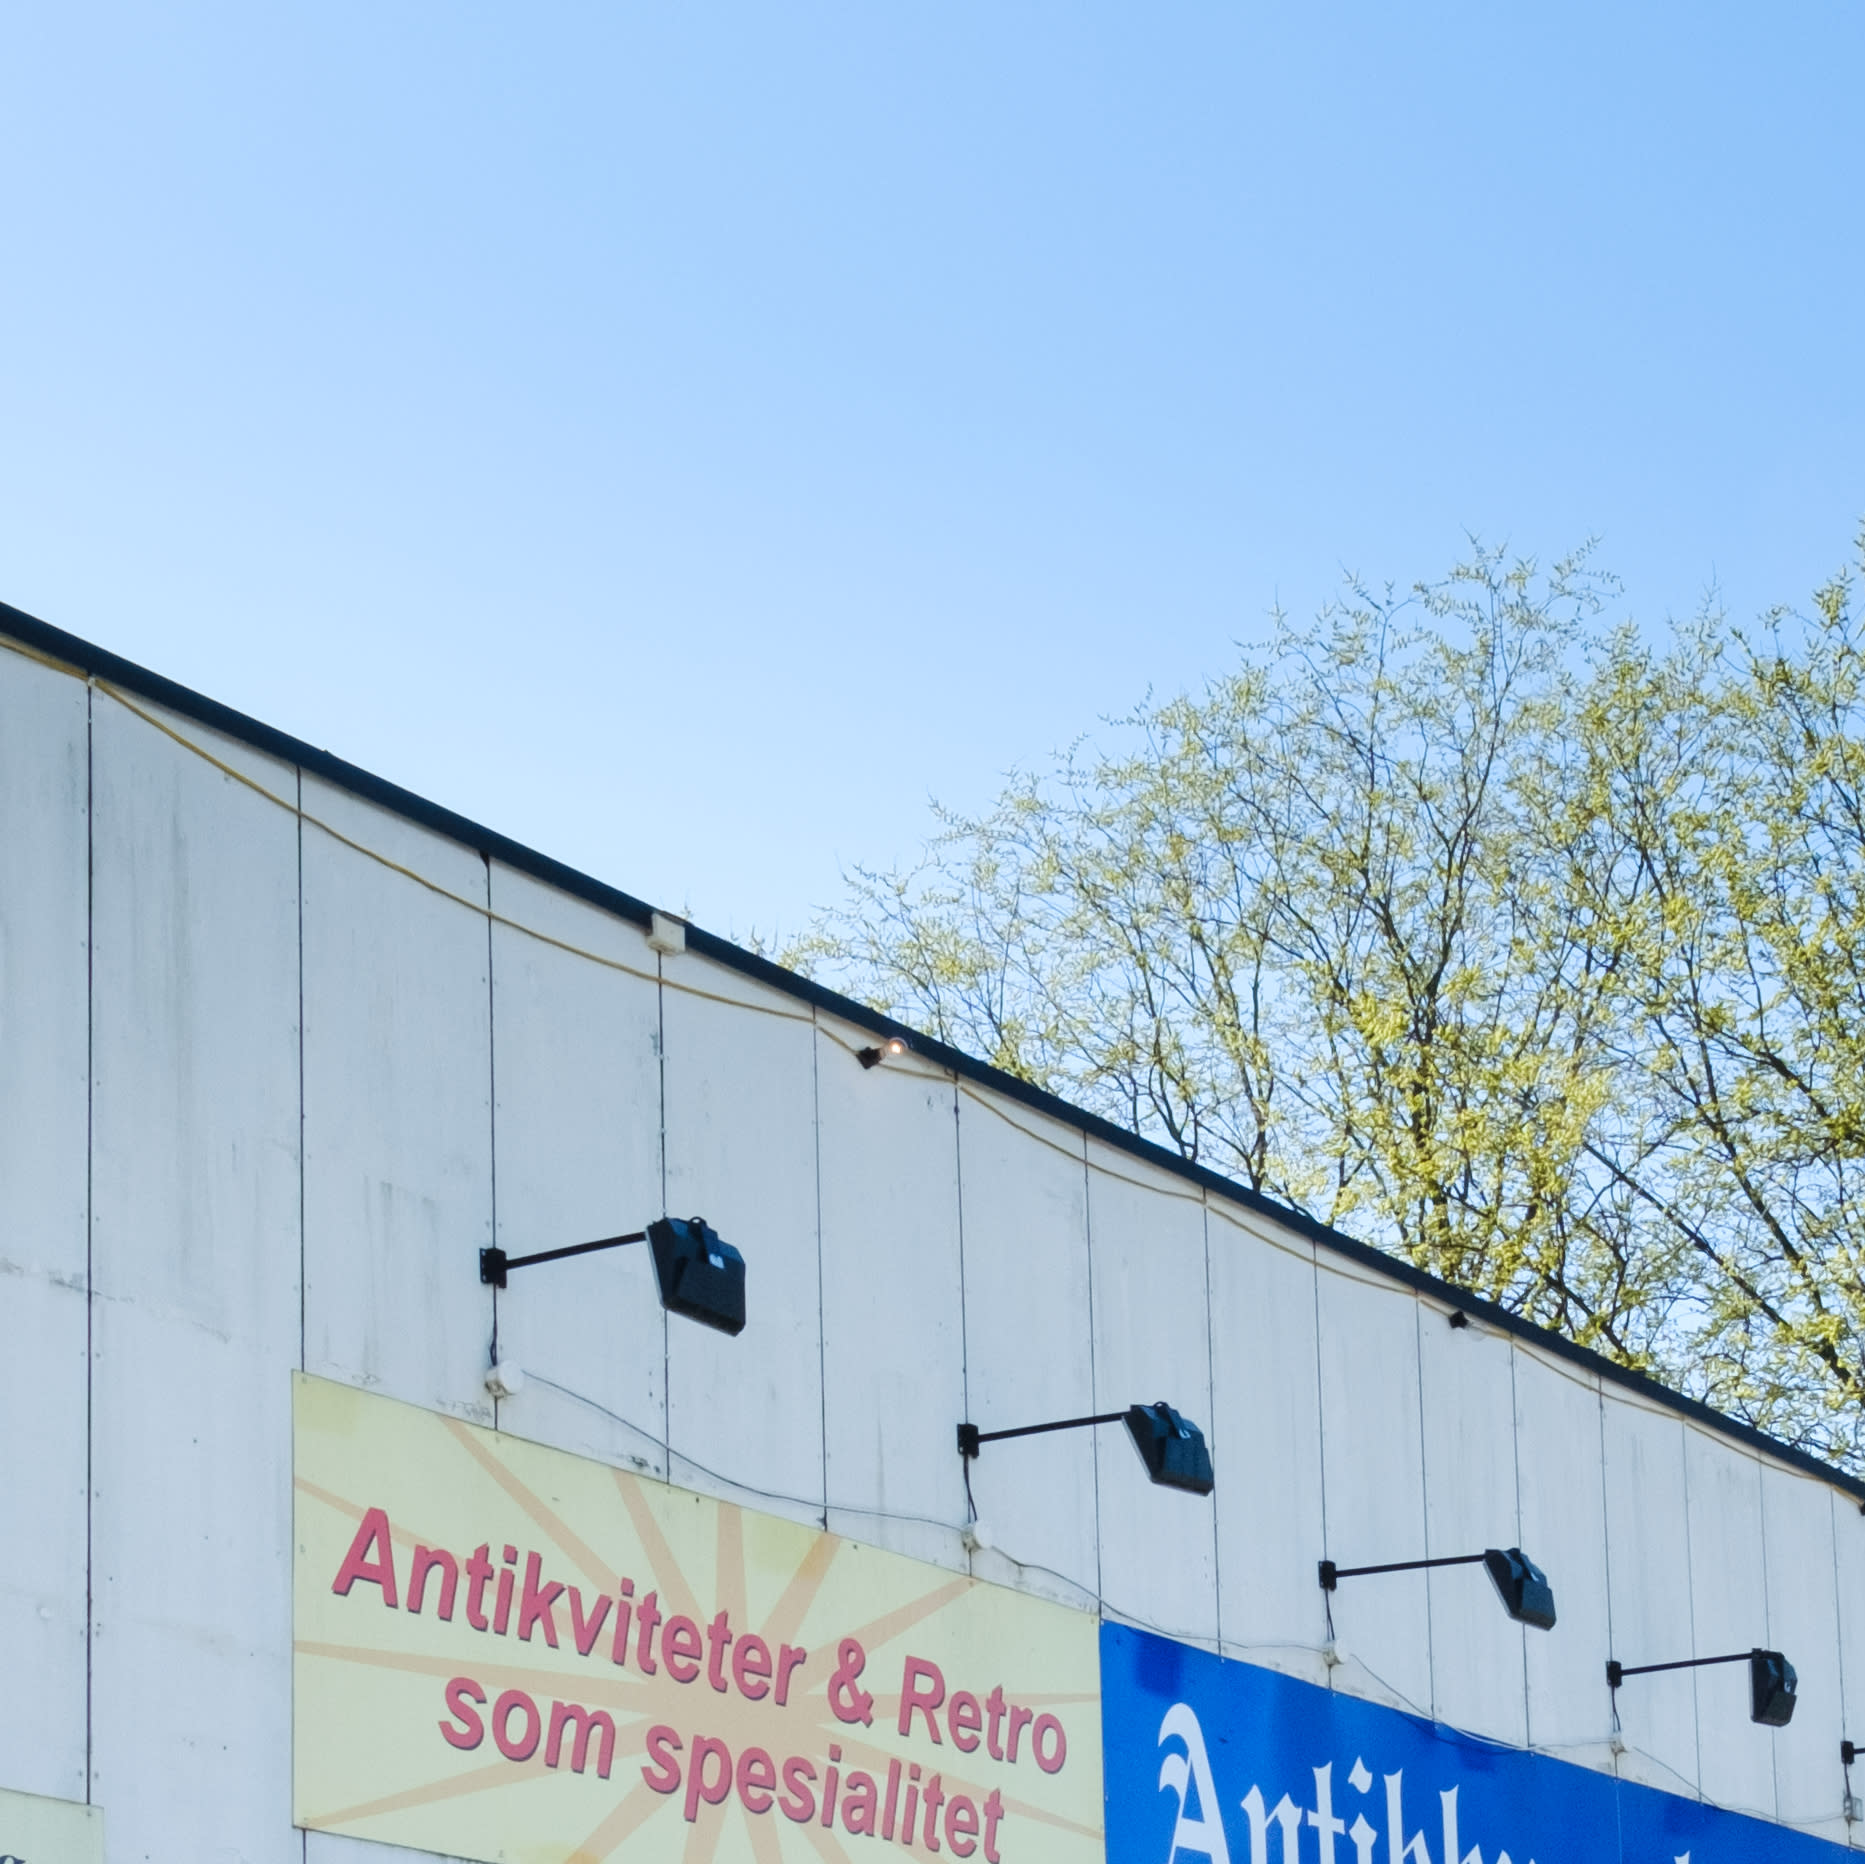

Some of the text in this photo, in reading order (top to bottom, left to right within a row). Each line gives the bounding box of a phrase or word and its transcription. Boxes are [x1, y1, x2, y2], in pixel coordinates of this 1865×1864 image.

[332, 1507, 1068, 1776] Antikviteter & Retro
[438, 1676, 1006, 1864] som spesialitet
